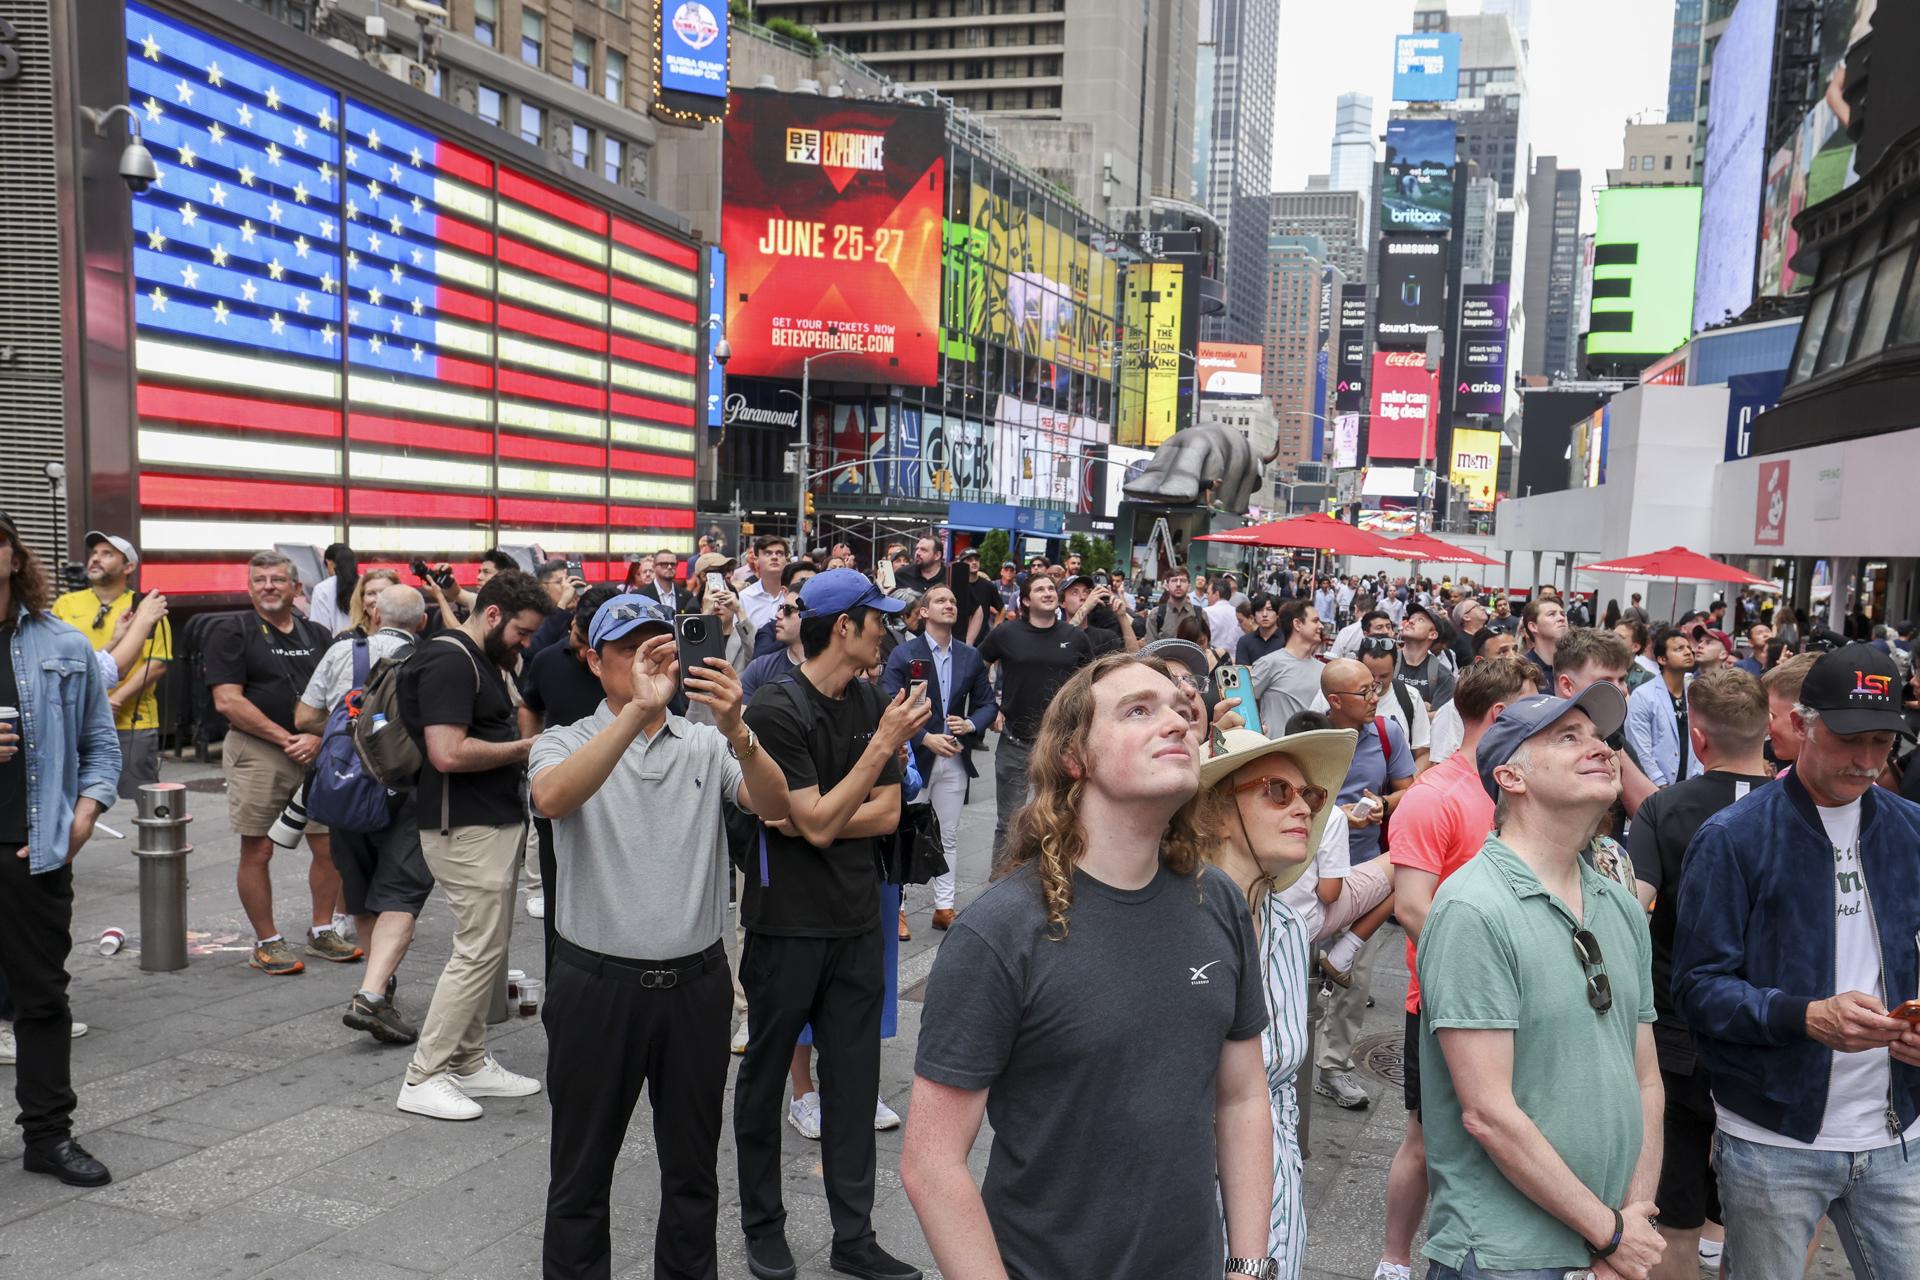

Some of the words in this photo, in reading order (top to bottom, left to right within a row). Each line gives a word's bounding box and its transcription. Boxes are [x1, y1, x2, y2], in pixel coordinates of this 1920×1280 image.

[823, 131, 884, 171] EXPERIENCE
[1391, 208, 1441, 223] britbox
[759, 218, 826, 258] JUNE
[833, 224, 905, 263] 25-27
[1388, 243, 1439, 254] SAMSUNG
[772, 317, 791, 327] GET
[796, 319, 822, 329] YOUR
[874, 324, 896, 334] NOW
[1379, 323, 1409, 333] Sound
[1156, 329, 1173, 337] THE
[772, 328, 894, 353] BETEXPERIENCE.COM
[1153, 340, 1175, 354] LION
[1150, 356, 1177, 370] KING
[1471, 381, 1501, 393] arize
[1381, 390, 1406, 403] mini
[1407, 393, 1427, 403] can
[725, 393, 798, 427] Paramount
[1381, 403, 1399, 420] big
[1400, 403, 1427, 418] deal
